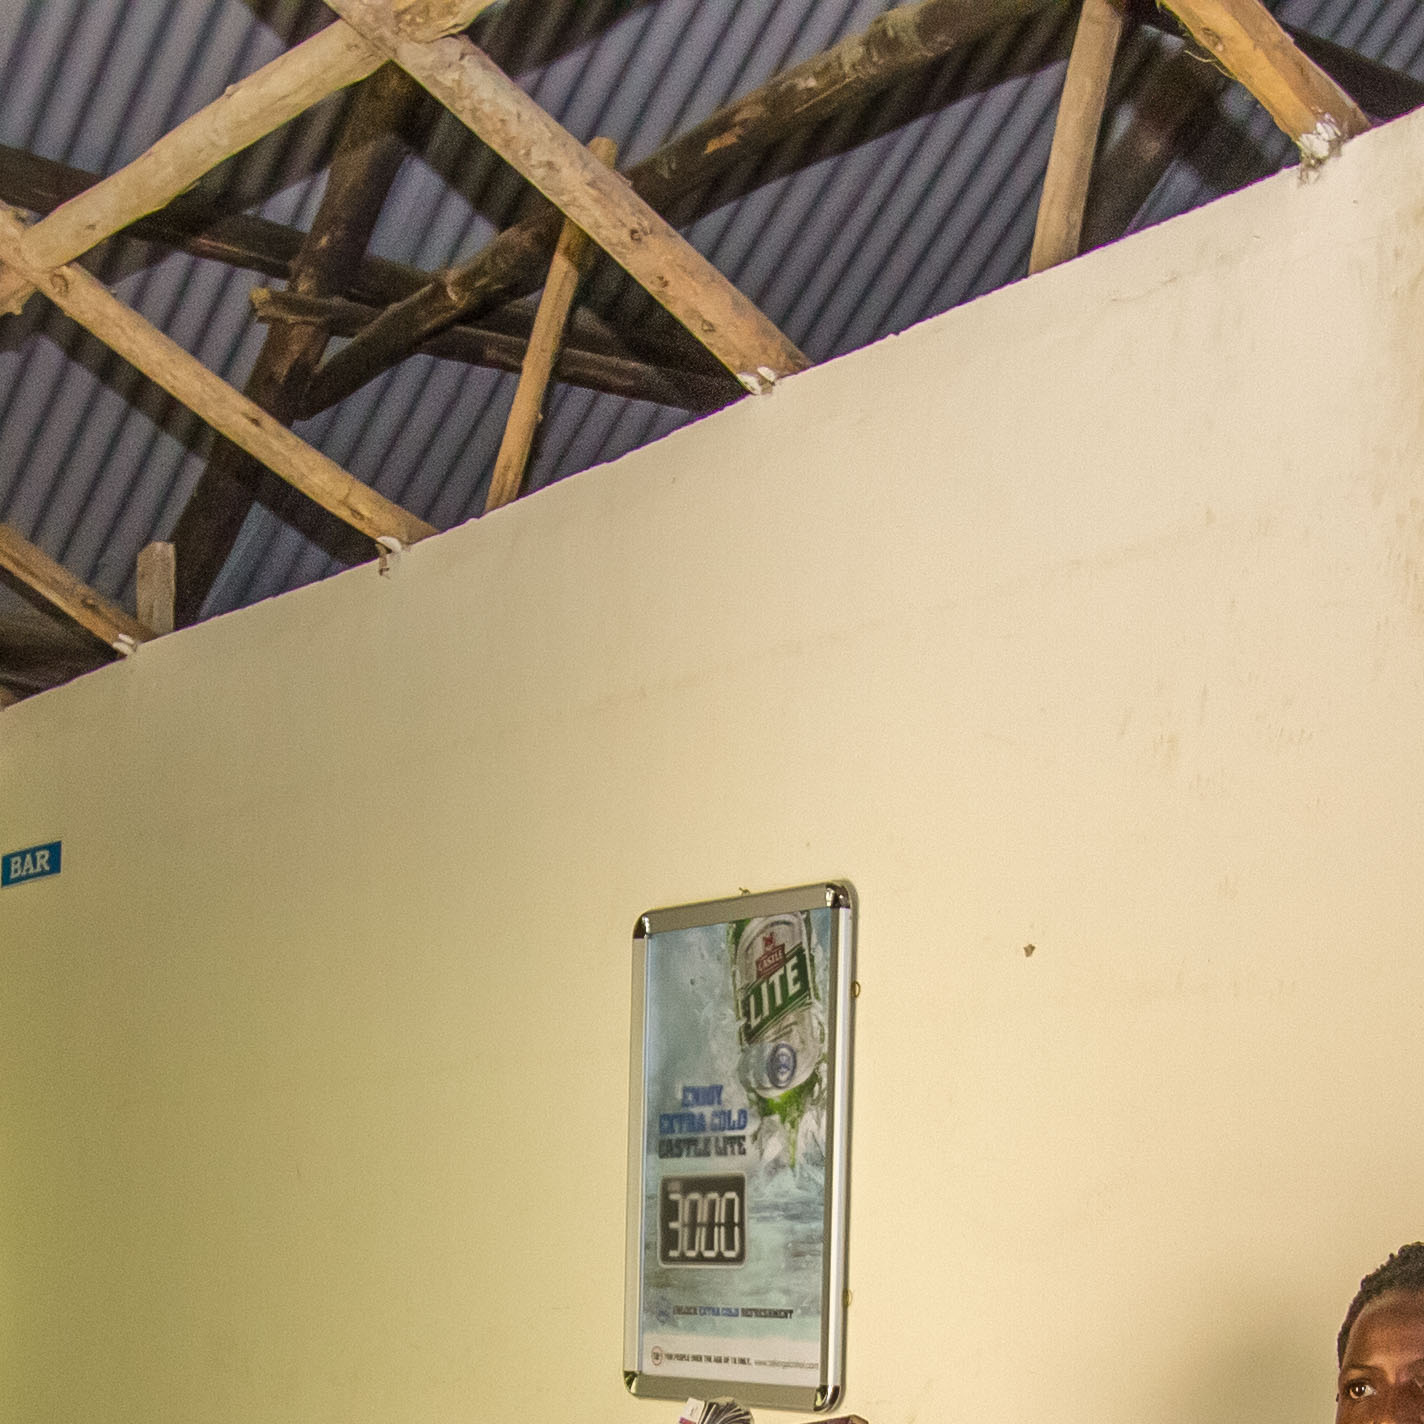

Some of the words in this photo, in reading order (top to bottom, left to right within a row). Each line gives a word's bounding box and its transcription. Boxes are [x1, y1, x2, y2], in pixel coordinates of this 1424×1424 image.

[9, 849, 51, 880] BAR
[757, 949, 784, 972] CASTLE
[749, 955, 801, 1030] LITE
[659, 1111, 707, 1135] EXTRA
[710, 1108, 748, 1132] COLD
[658, 1137, 711, 1159] CASTLE
[714, 1135, 746, 1156] LITE
[668, 1191, 740, 1257] 3000
